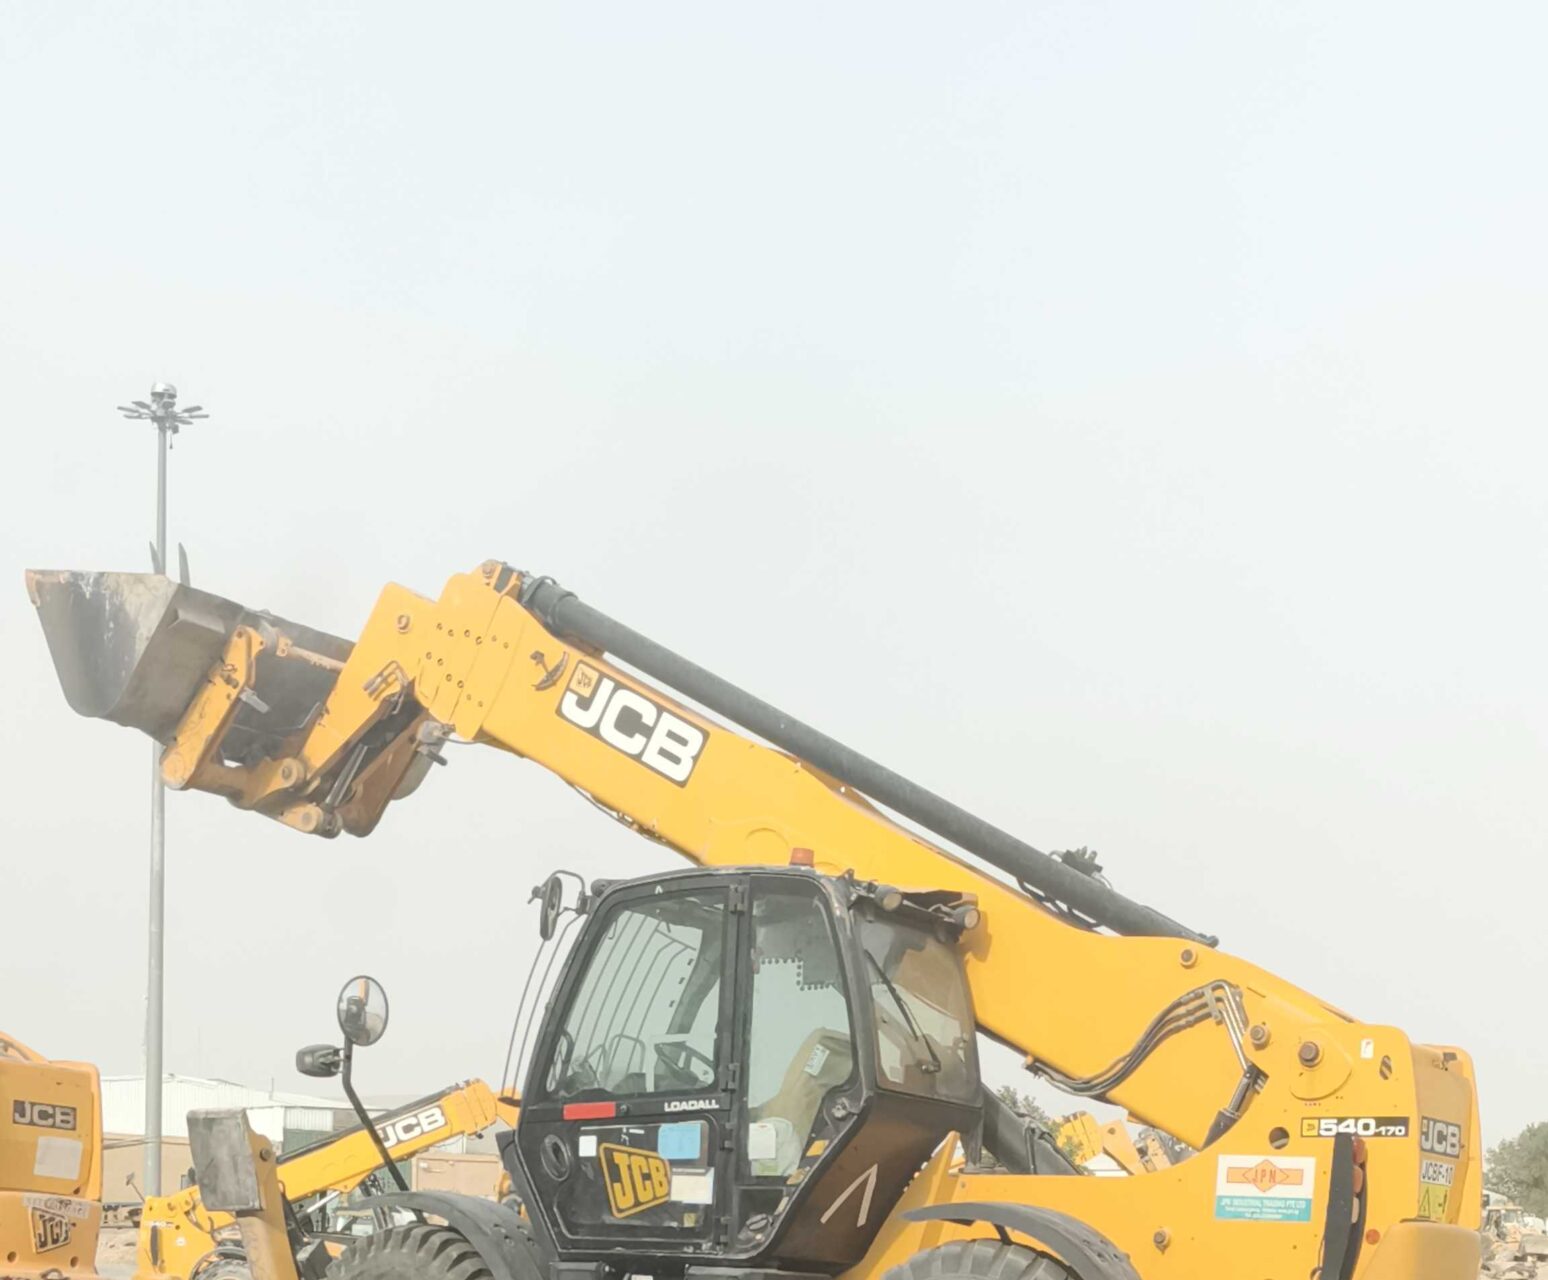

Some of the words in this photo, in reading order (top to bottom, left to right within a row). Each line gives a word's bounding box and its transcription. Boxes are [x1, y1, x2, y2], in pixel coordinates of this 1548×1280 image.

[560, 677, 704, 782] JCB
[14, 1101, 75, 1129] JCB
[664, 1099, 719, 1112] LOADALL
[377, 1106, 446, 1149] JCB
[1421, 1117, 1460, 1156] JCB
[612, 1151, 670, 1209] JCB
[1252, 1168, 1277, 1184] JPN
